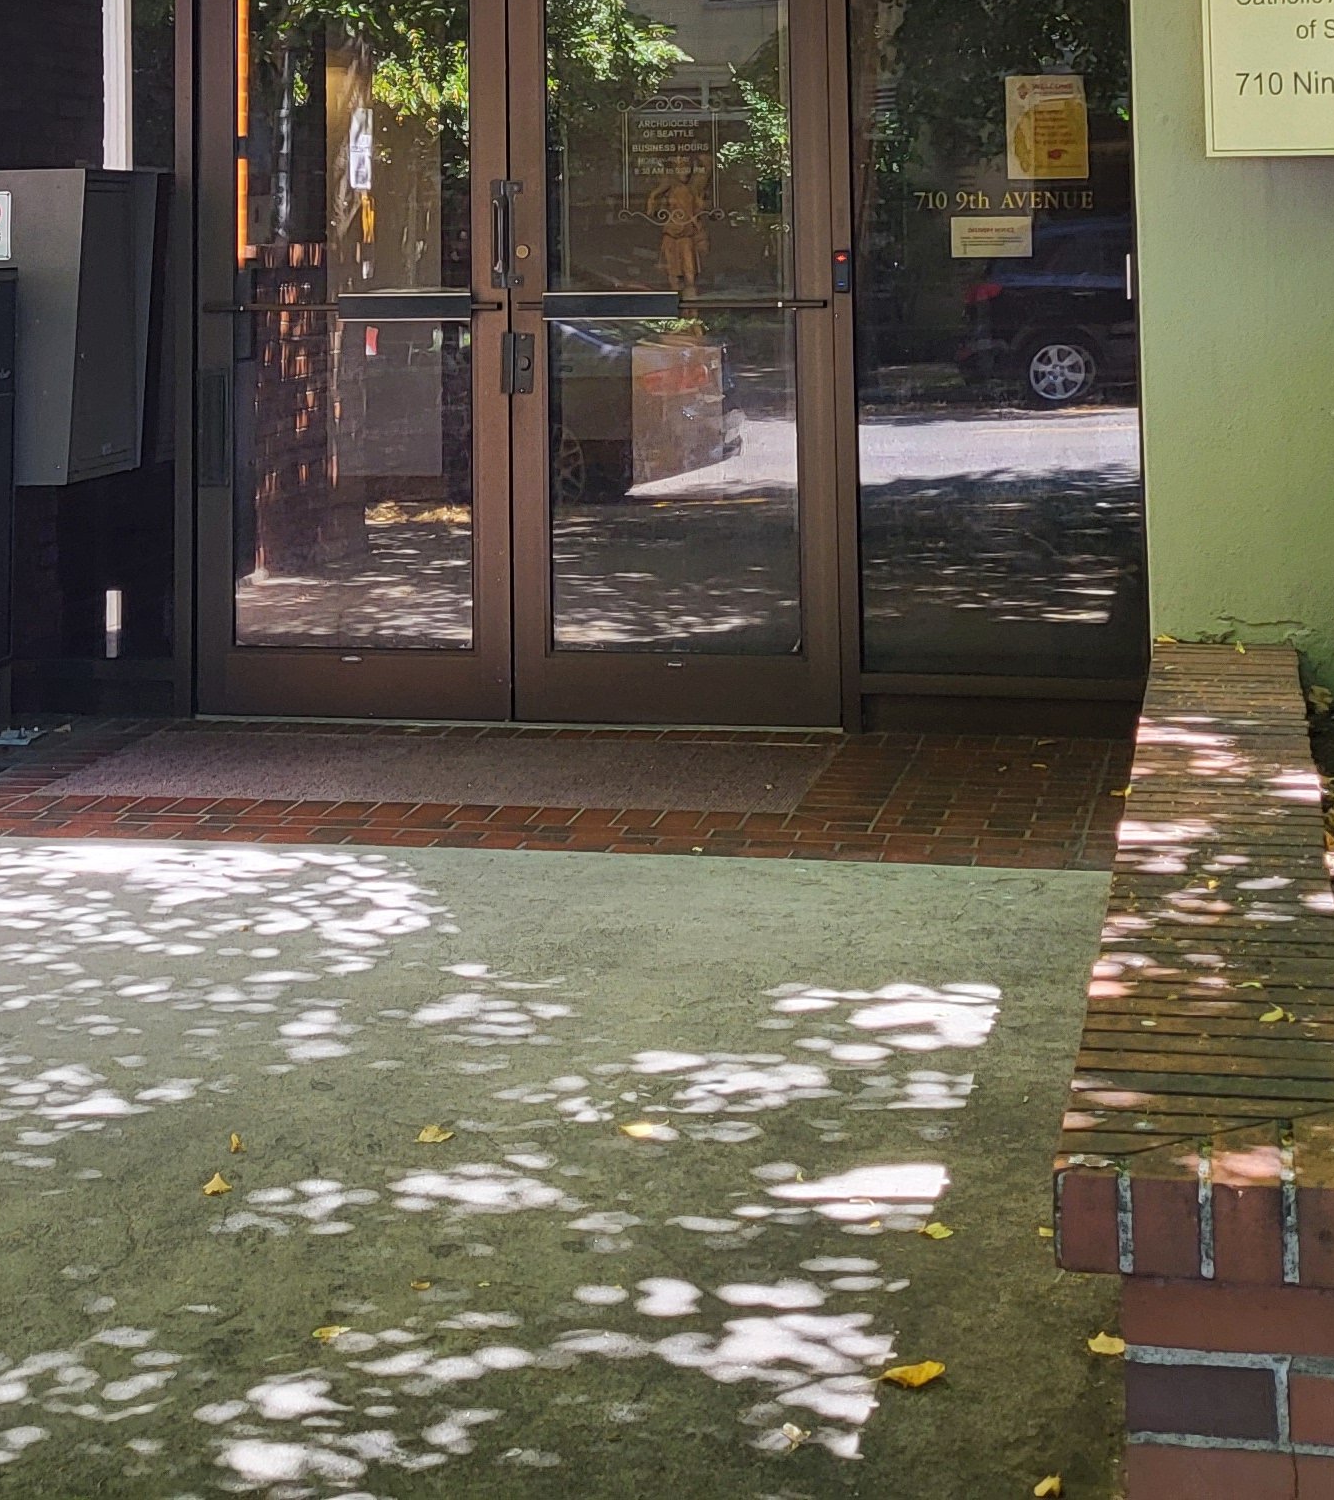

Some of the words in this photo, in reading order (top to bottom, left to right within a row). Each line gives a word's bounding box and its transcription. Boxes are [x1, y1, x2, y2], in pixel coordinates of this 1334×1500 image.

[1296, 19, 1317, 40] of
[1235, 72, 1283, 96] 710
[638, 120, 699, 128] ARCHDIOCESE
[643, 130, 655, 138] OF
[656, 129, 694, 138] SEATTLE
[632, 144, 676, 152] BUSINESS
[677, 143, 709, 152] HOURS
[913, 192, 948, 211] 710
[955, 190, 990, 211] 9th
[1000, 191, 1094, 210] AVENUE
